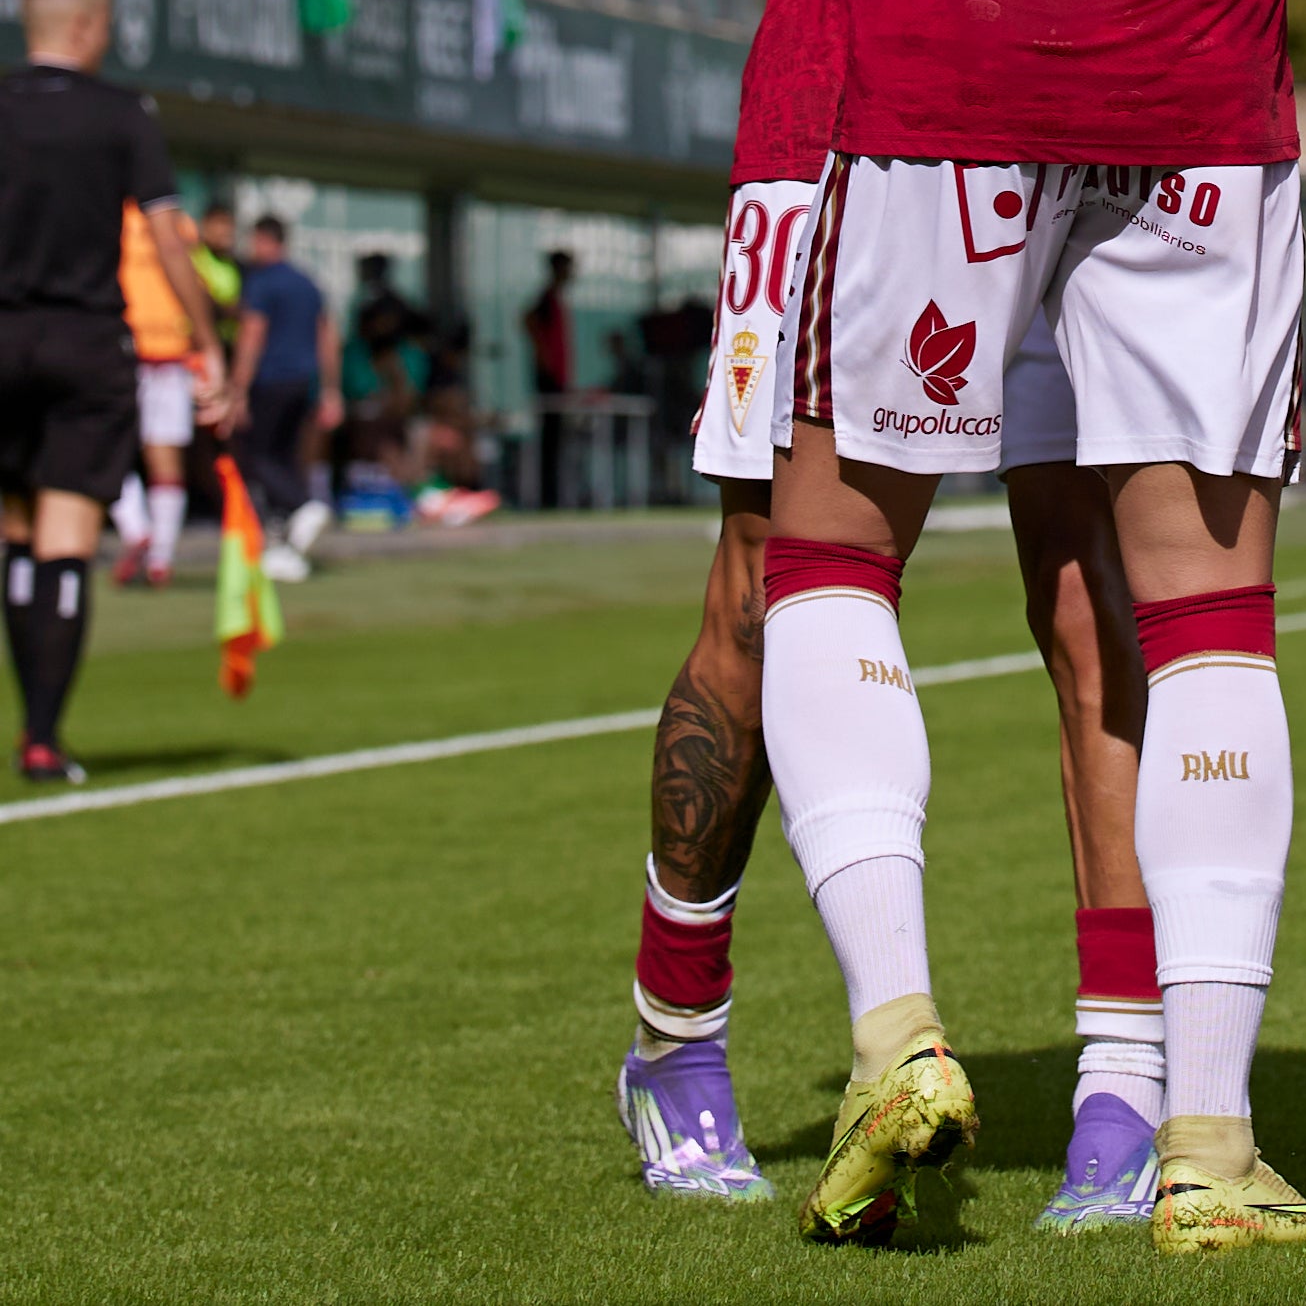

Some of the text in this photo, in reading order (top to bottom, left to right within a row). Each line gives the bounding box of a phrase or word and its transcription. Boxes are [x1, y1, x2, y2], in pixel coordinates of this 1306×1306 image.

[1102, 197, 1207, 256] Inmobiliarios
[725, 199, 811, 318] 30
[872, 407, 1002, 439] grupolucas
[858, 658, 914, 695] RMU
[1180, 750, 1250, 783] RMU
